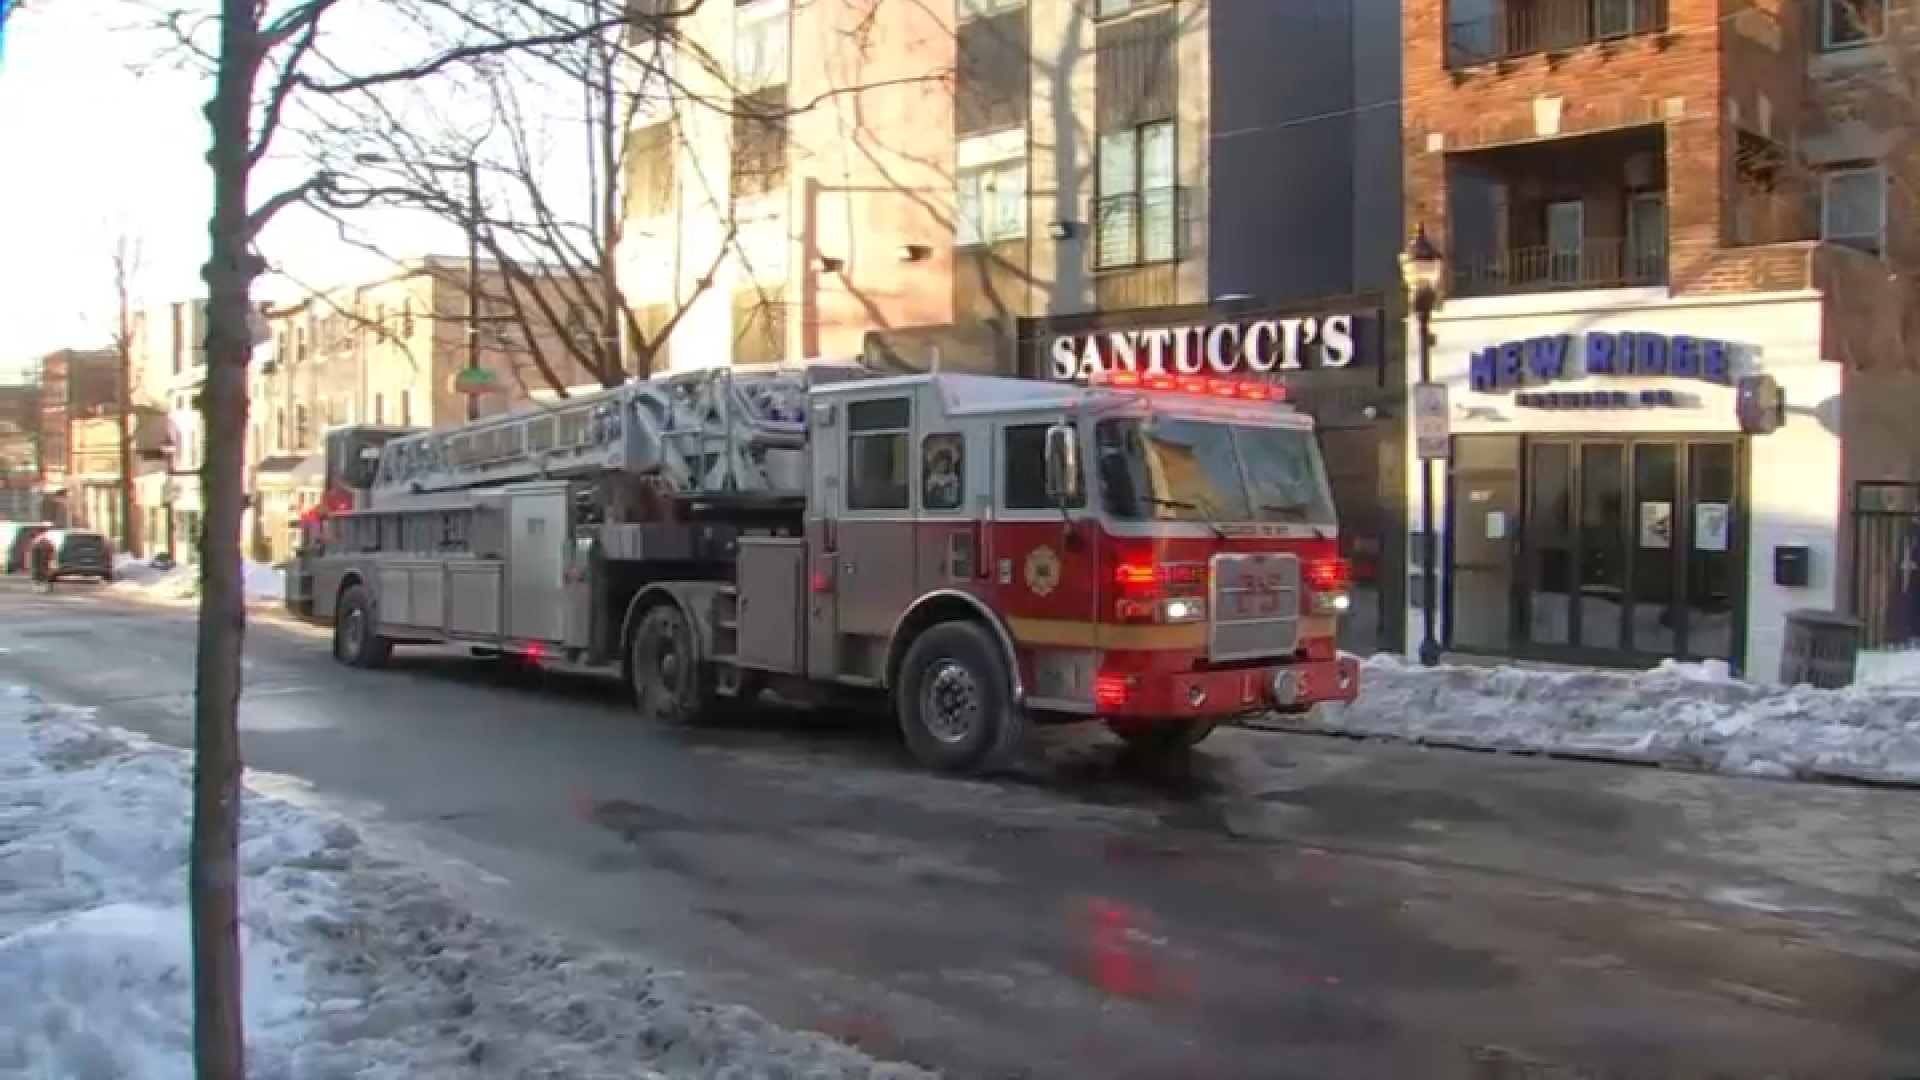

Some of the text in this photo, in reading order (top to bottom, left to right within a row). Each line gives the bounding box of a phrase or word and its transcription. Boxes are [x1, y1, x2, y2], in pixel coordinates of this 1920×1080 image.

[1052, 315, 1355, 379] SANTUCCI'S
[1469, 331, 1726, 393] NEW RIDGE
